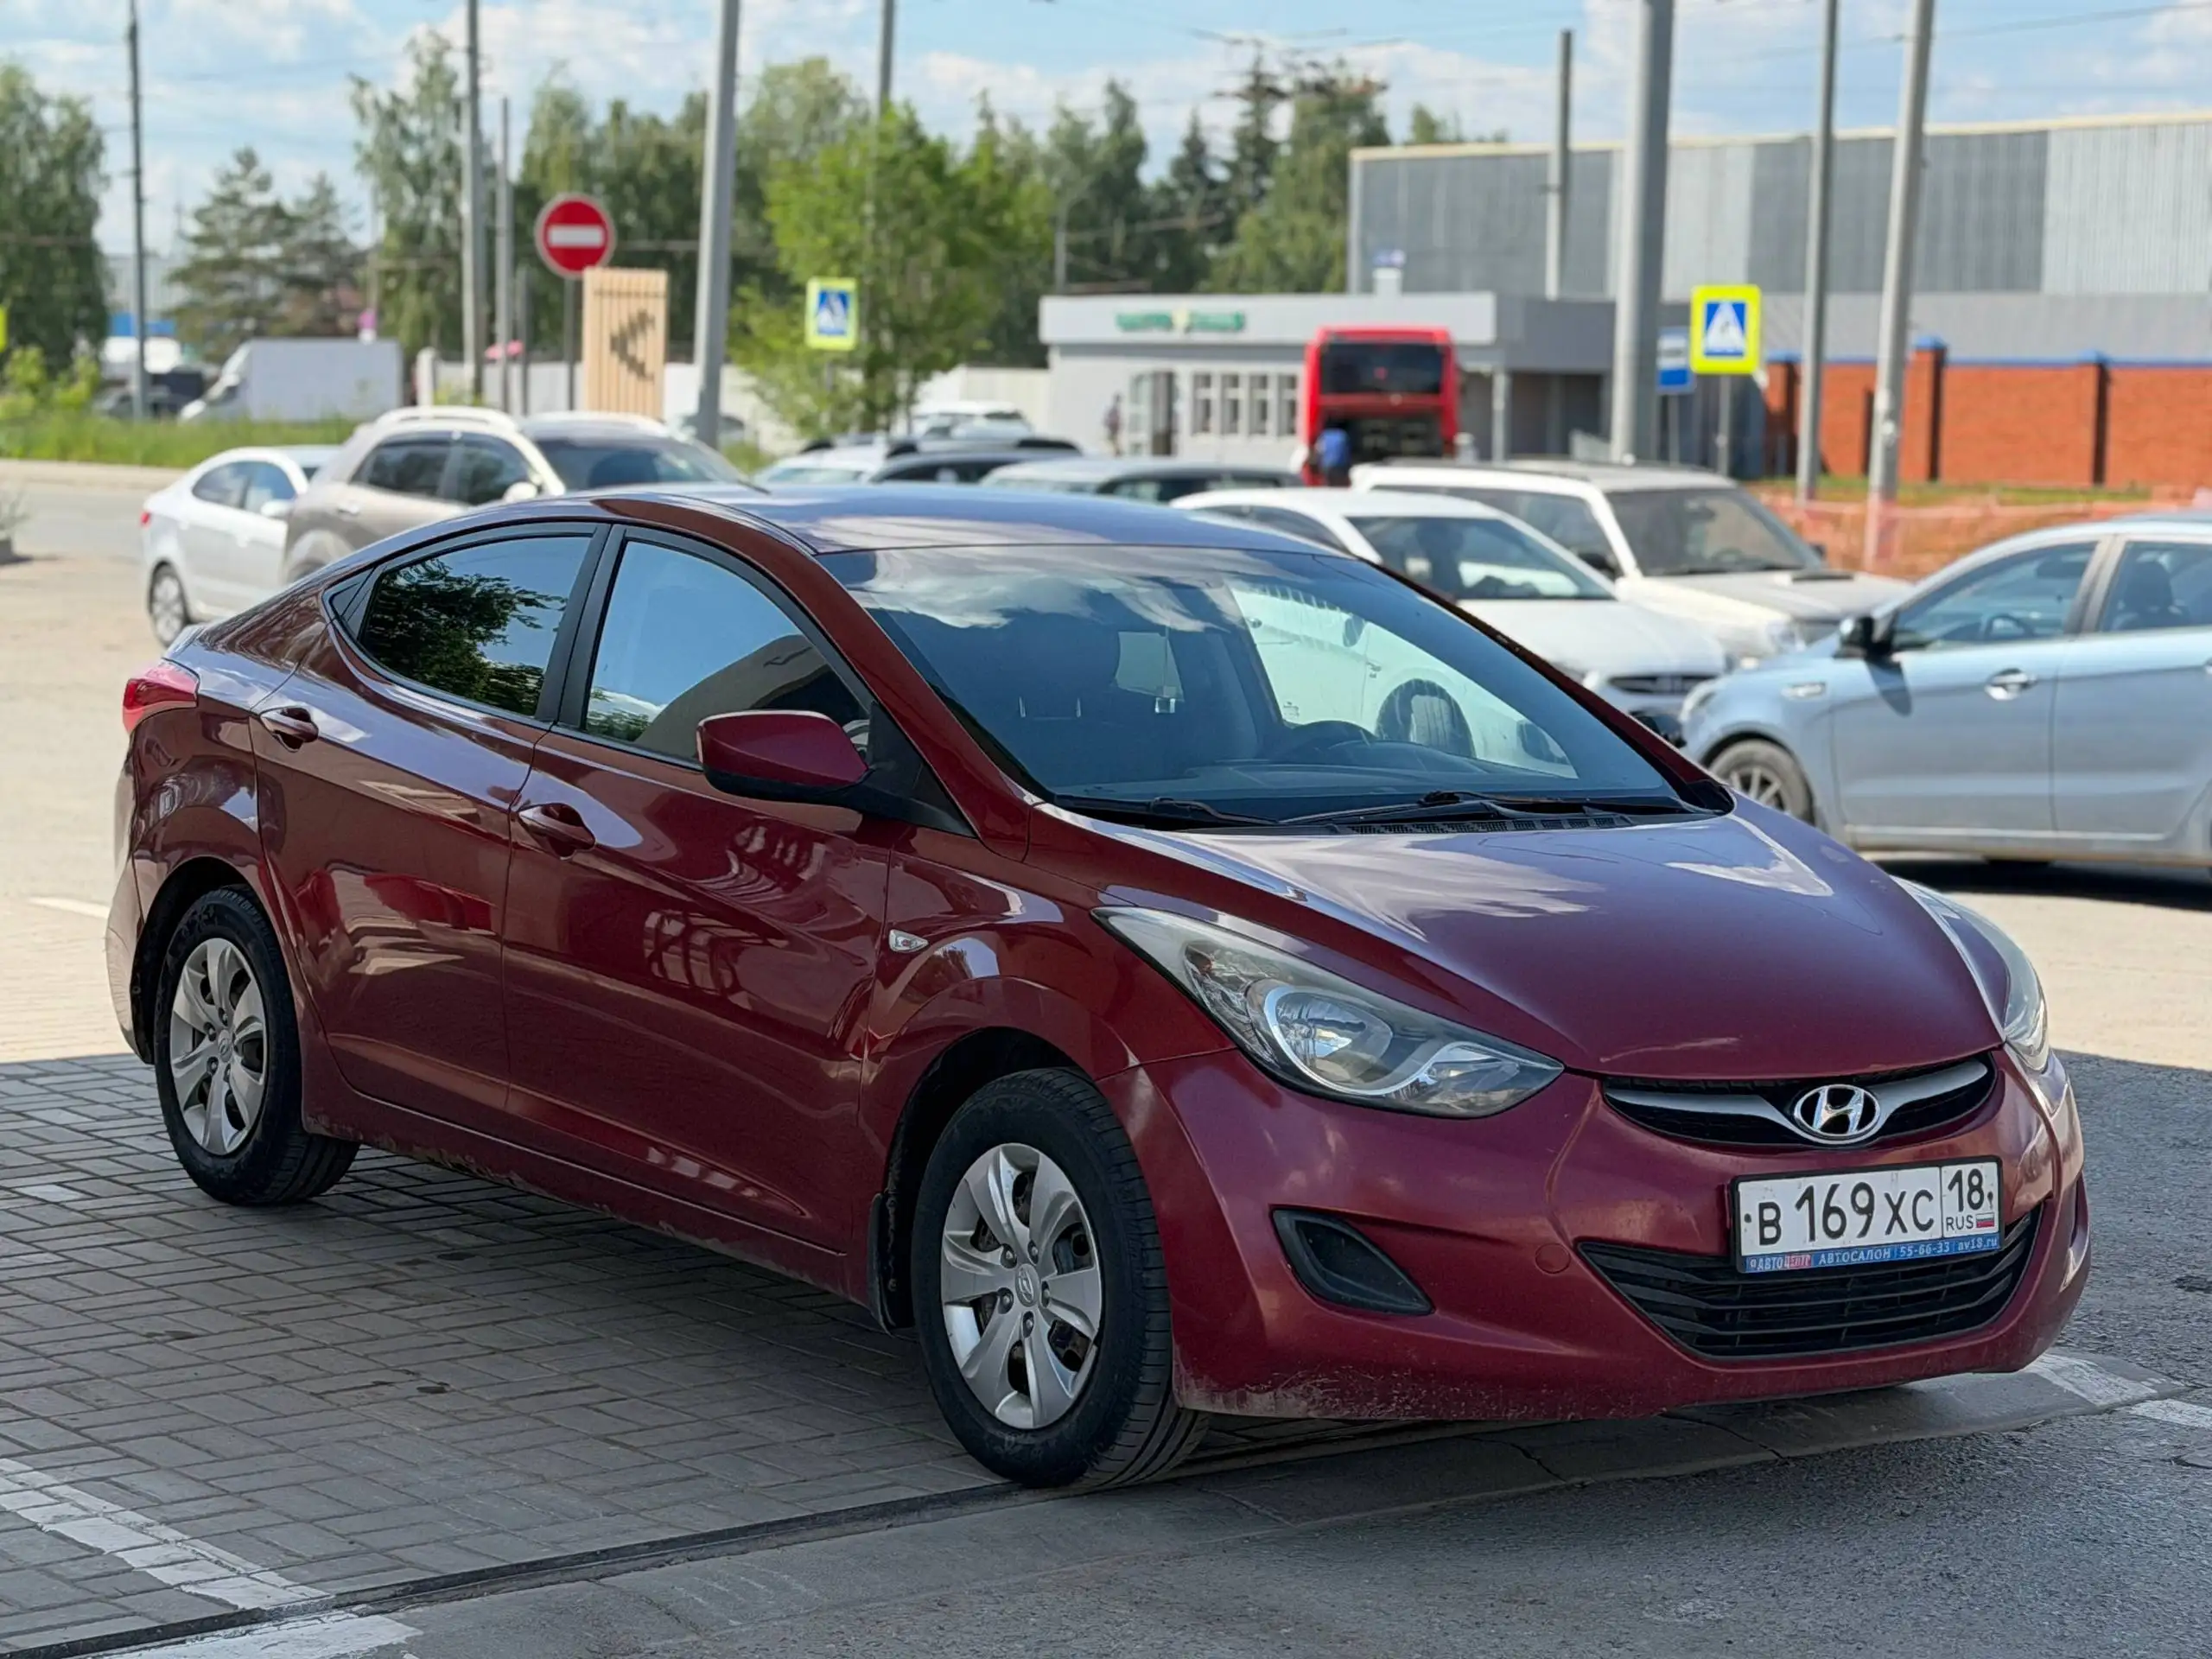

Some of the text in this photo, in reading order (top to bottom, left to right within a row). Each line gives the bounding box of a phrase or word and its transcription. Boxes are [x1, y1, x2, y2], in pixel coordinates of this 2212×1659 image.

[1948, 1168, 1984, 1212] 18
[1945, 1214, 1974, 1231] RUS
[1819, 1249, 1891, 1265] АВТОСАЛОН
[1899, 1242, 1950, 1257] 55-66-33
